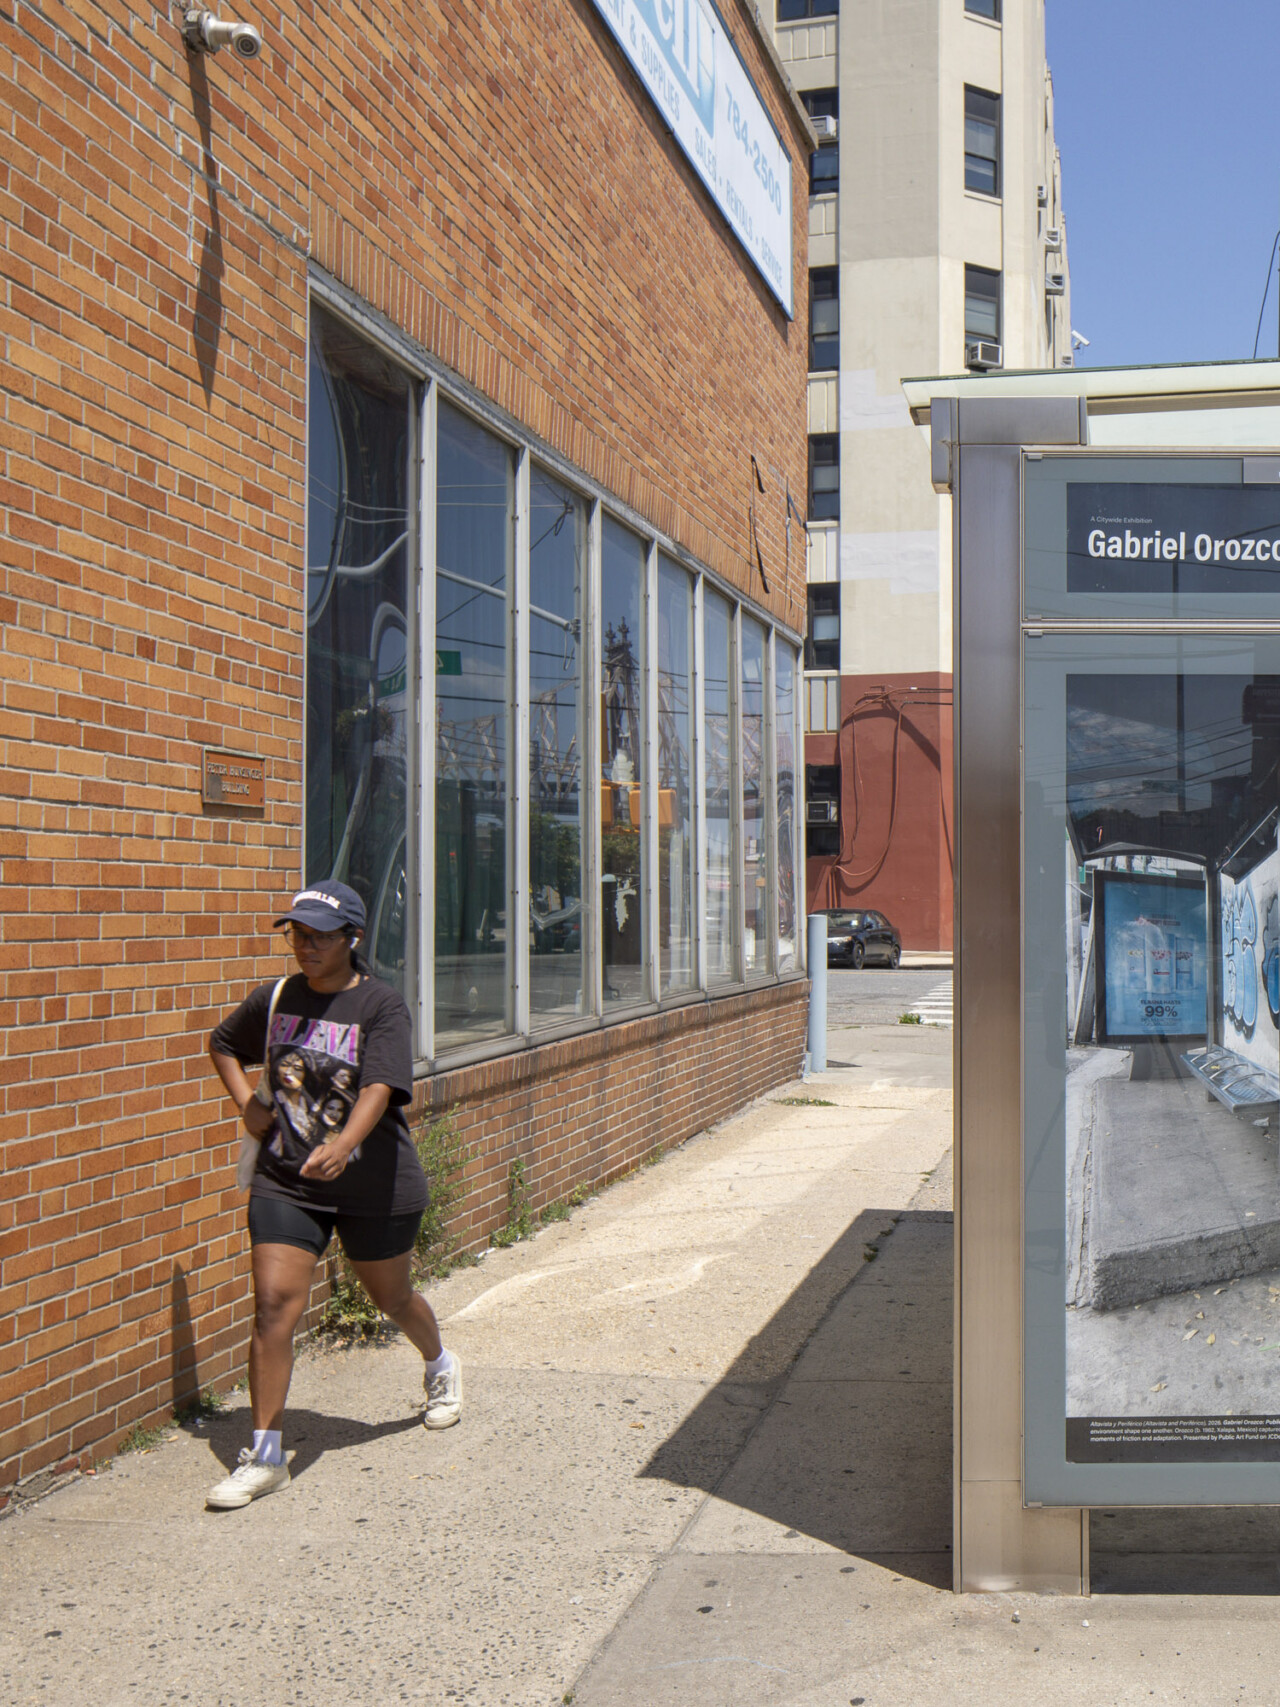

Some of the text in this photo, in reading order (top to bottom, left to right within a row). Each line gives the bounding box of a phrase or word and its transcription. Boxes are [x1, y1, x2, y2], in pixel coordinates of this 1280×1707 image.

[641, 33, 680, 122] SUPPLIES
[725, 82, 782, 216] 784-2500
[695, 127, 782, 289] SALES RENTALS SERVICE
[1096, 516, 1122, 525] Citywide
[1123, 517, 1152, 525] Exhibition
[1088, 530, 1186, 560] Gabriel
[222, 781, 250, 795] BUILDING
[1144, 1005, 1178, 1018] 99%
